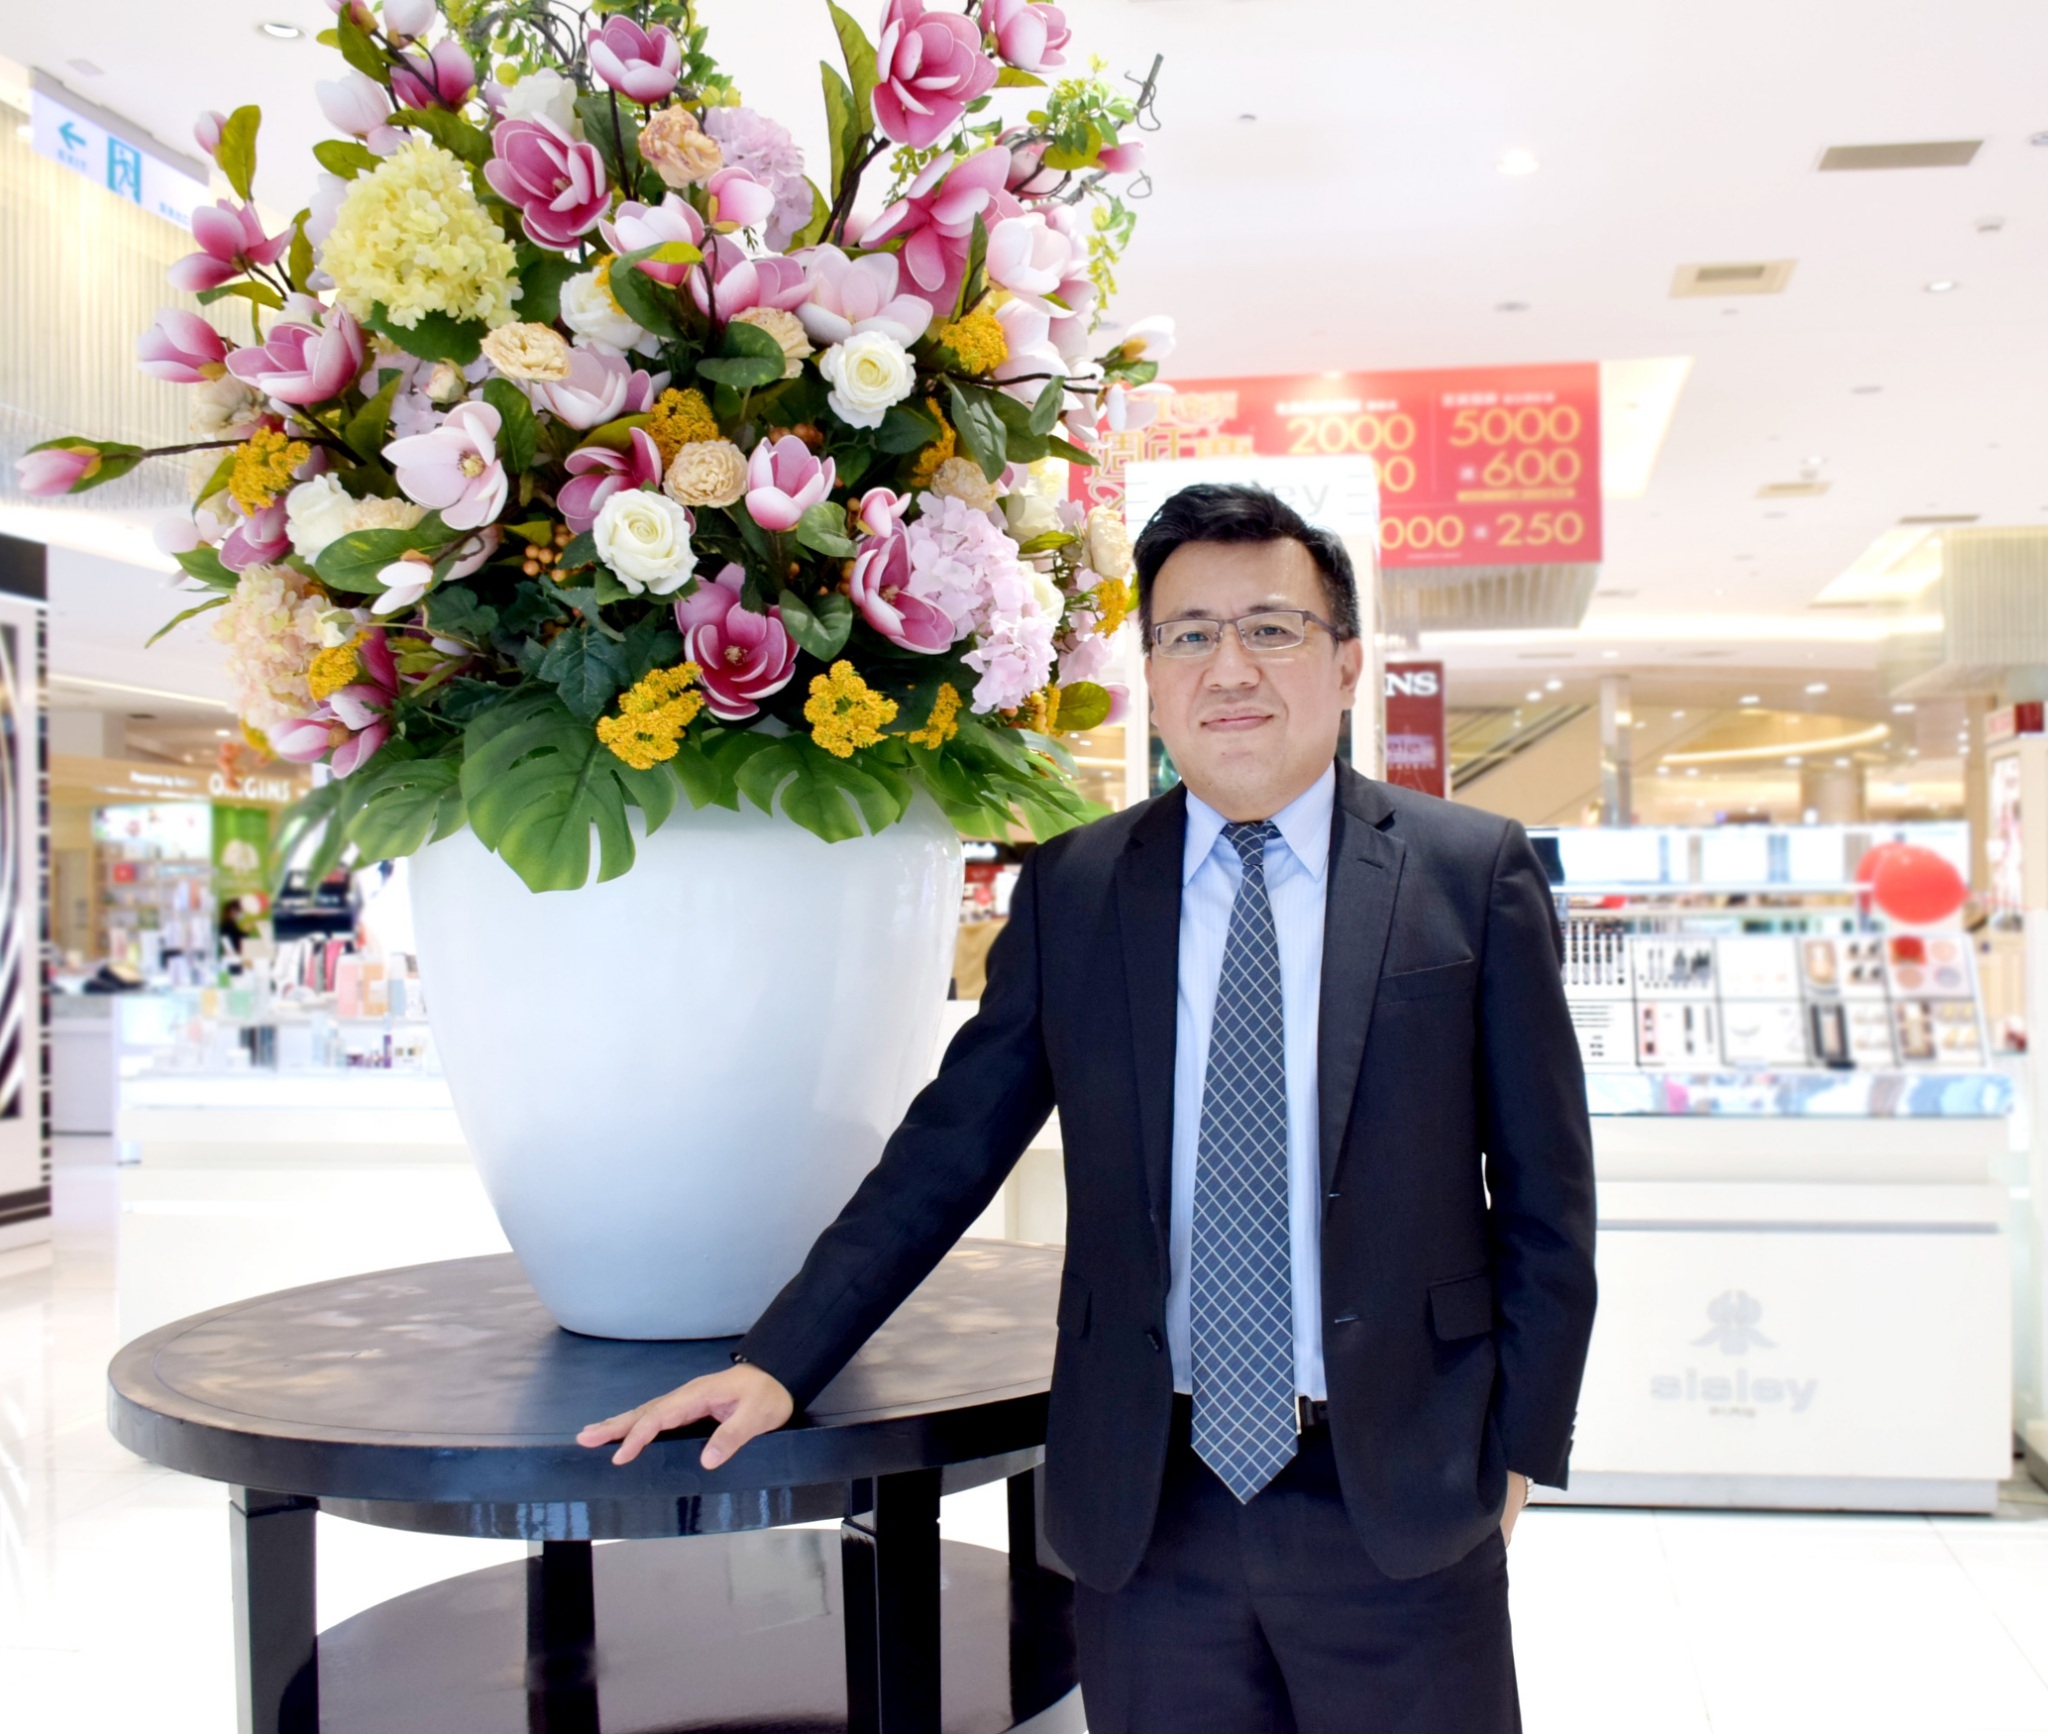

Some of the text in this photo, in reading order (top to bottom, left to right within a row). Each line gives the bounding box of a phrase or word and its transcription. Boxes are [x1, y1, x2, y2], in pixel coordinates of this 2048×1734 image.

[1287, 413, 1416, 454] 2000
[1448, 404, 1582, 448] 5000
[1482, 447, 1582, 487] 600
[1496, 510, 1584, 547] 250
[1385, 670, 1440, 697] NS
[209, 772, 290, 802] OGINS
[1650, 1367, 1822, 1414] sisley
